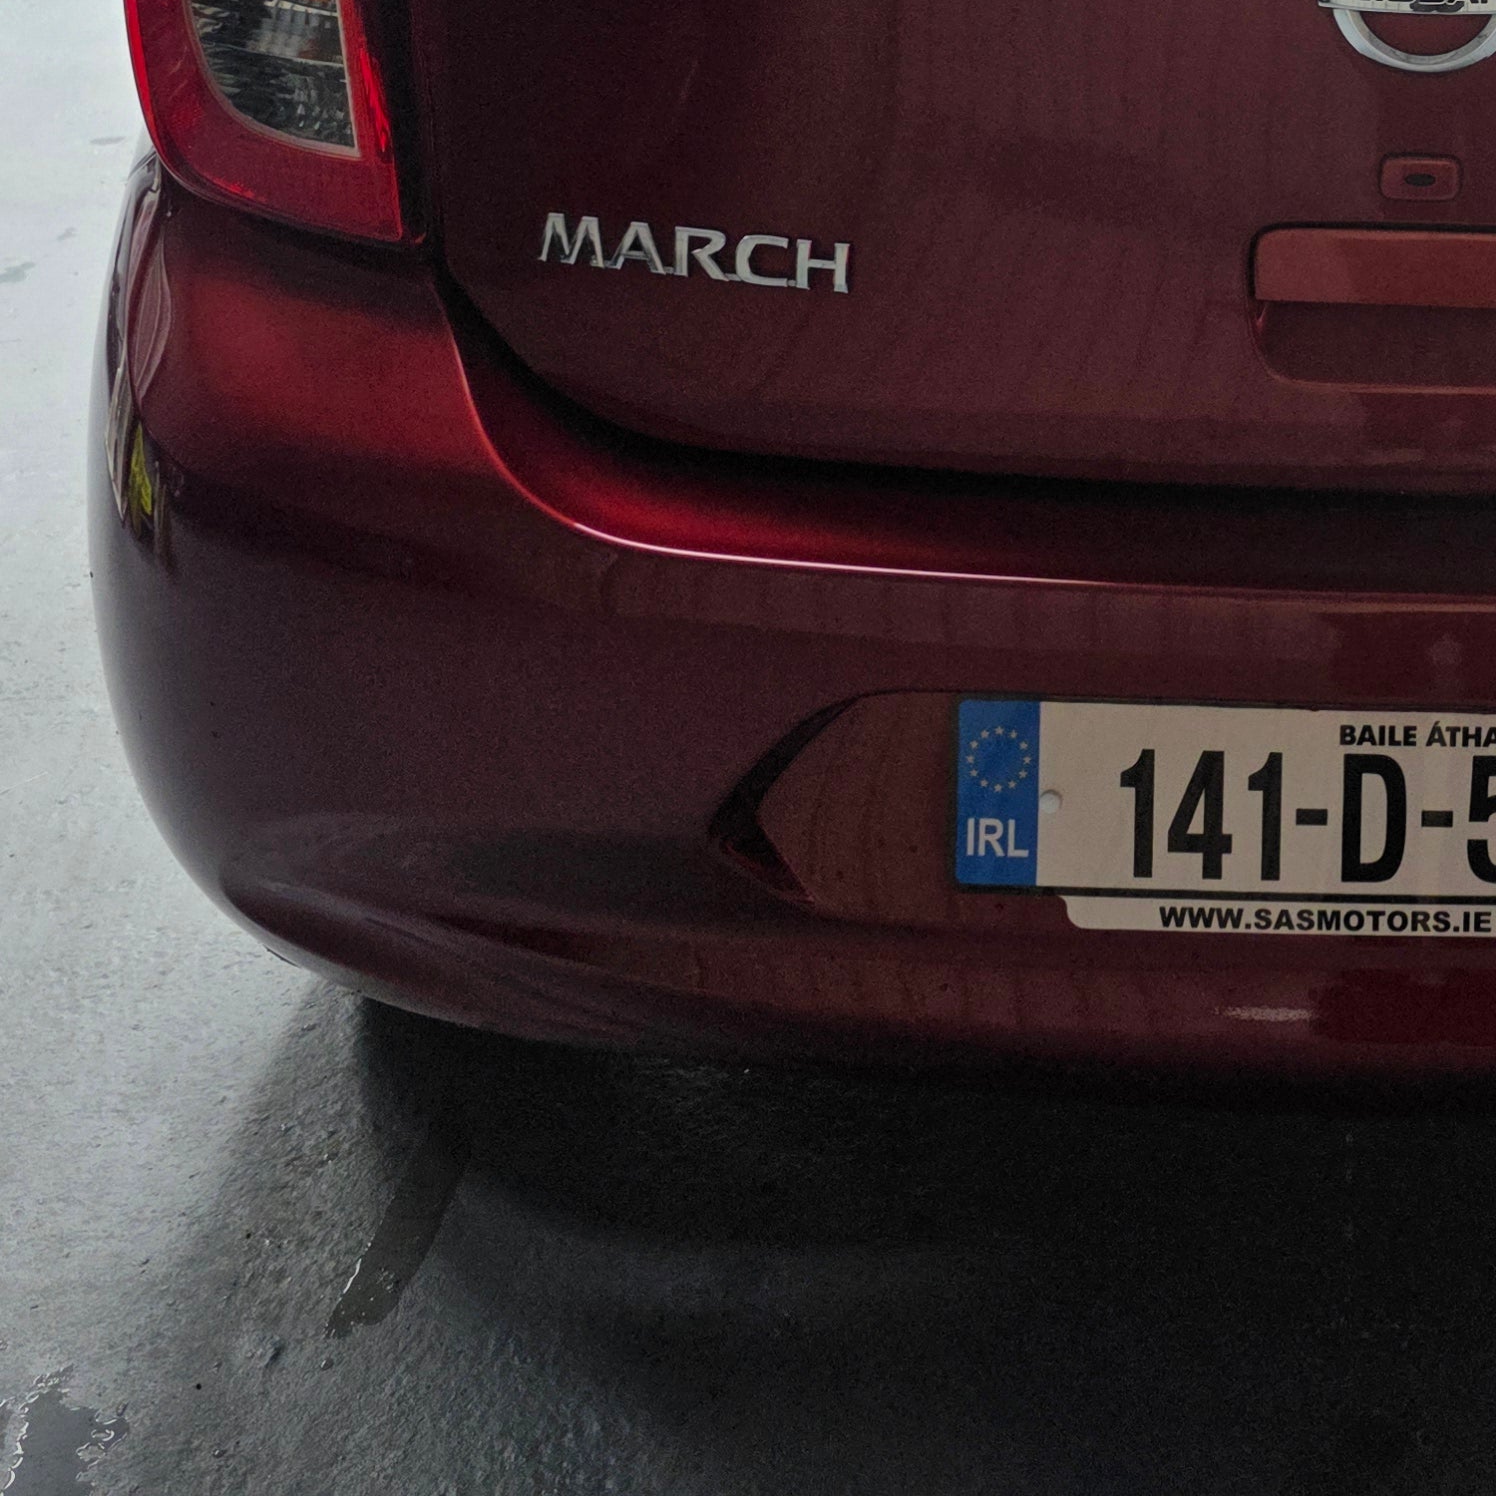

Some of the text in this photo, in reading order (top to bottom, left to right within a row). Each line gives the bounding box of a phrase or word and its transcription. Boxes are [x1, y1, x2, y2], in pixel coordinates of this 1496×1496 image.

[537, 212, 850, 293] MARCH
[1339, 724, 1418, 747] BAILE
[965, 816, 1029, 858] IRL
[1159, 906, 1493, 934] WWW.SASMOTORS.IE
